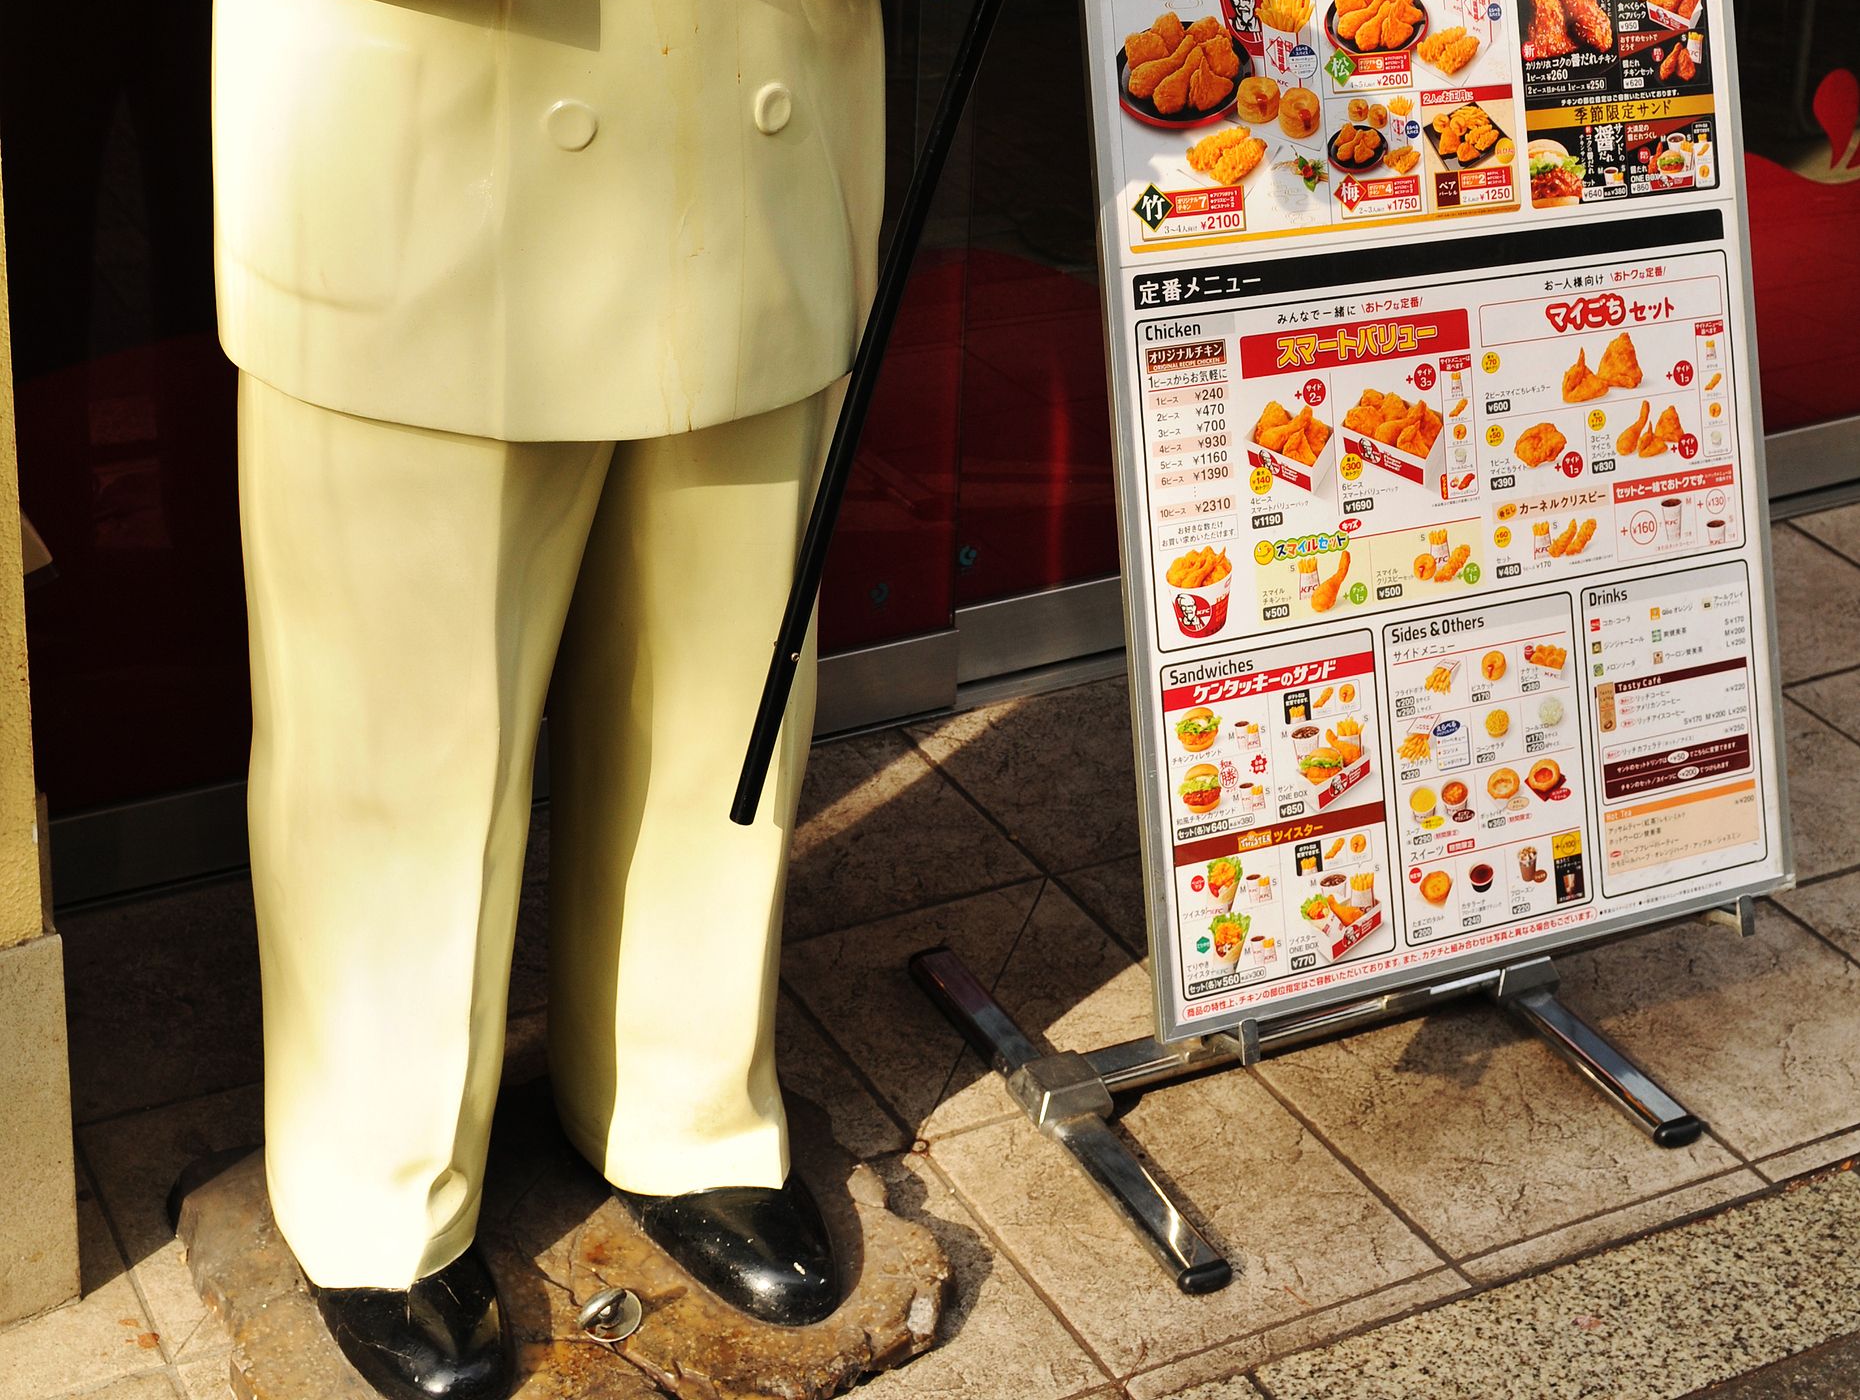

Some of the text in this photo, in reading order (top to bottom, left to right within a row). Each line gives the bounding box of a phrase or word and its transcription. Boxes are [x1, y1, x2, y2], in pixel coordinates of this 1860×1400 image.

[1620, 21, 1637, 30] ¥950
[1524, 43, 1535, 58] 新
[1332, 57, 1350, 77] 松
[1546, 69, 1568, 80] ¥260
[1377, 74, 1408, 85] ¥2600
[1574, 100, 1672, 124] 季節限定サンド
[1341, 182, 1360, 203] 梅
[1480, 188, 1510, 201] ¥1250
[1142, 194, 1165, 221] 竹
[1387, 198, 1417, 211] ¥1750
[1201, 214, 1240, 230] ¥2100
[1139, 275, 1262, 306] 定番メニュー
[1544, 274, 1603, 291] お一人様向け
[1276, 304, 1356, 325] みんなで一緒に
[1549, 297, 1675, 327] マイごちセット
[1145, 321, 1202, 341] Chicken
[1149, 343, 1223, 365] オリジナルチキン
[1276, 322, 1438, 369] スマートバリュー
[1148, 368, 1228, 390] 1ピースからお気軽に
[1195, 387, 1224, 402] ¥240
[1157, 403, 1225, 422] 2ピース ¥470
[1488, 401, 1509, 413] ¥600
[1157, 419, 1226, 437] 3ピース ¥700
[1159, 435, 1227, 453] 4ピース ¥930
[1160, 450, 1228, 470] 5ピース ¥1160
[1593, 461, 1614, 472] ¥830
[1161, 467, 1229, 486] 6ピース ¥1390
[1493, 477, 1514, 488] ¥390
[1159, 497, 1231, 518] 10ピース ¥2310
[1345, 500, 1372, 512] ¥1690
[1519, 494, 1607, 515] カーネルクリスピー
[1254, 514, 1280, 527] ¥1190
[1276, 535, 1346, 556] スマイルセット
[1499, 565, 1520, 576] ¥480
[1300, 584, 1318, 594] KFC
[1379, 586, 1401, 597] ¥500
[1589, 589, 1628, 606] Drinks
[1265, 606, 1288, 618] ¥500
[1392, 625, 1427, 644] Sides
[1442, 616, 1485, 634] Others
[1394, 643, 1456, 661] サイドメニュー
[1170, 659, 1254, 686] Sandwiches
[1193, 660, 1337, 704] ケンタッキーのサンド
[1618, 679, 1641, 691] Tasty
[1278, 790, 1308, 802] ONE BOX
[1281, 803, 1303, 816] ¥850
[1274, 824, 1323, 842] ツイスター
[1289, 944, 1305, 954] ONE
[1292, 956, 1315, 968] ¥770
